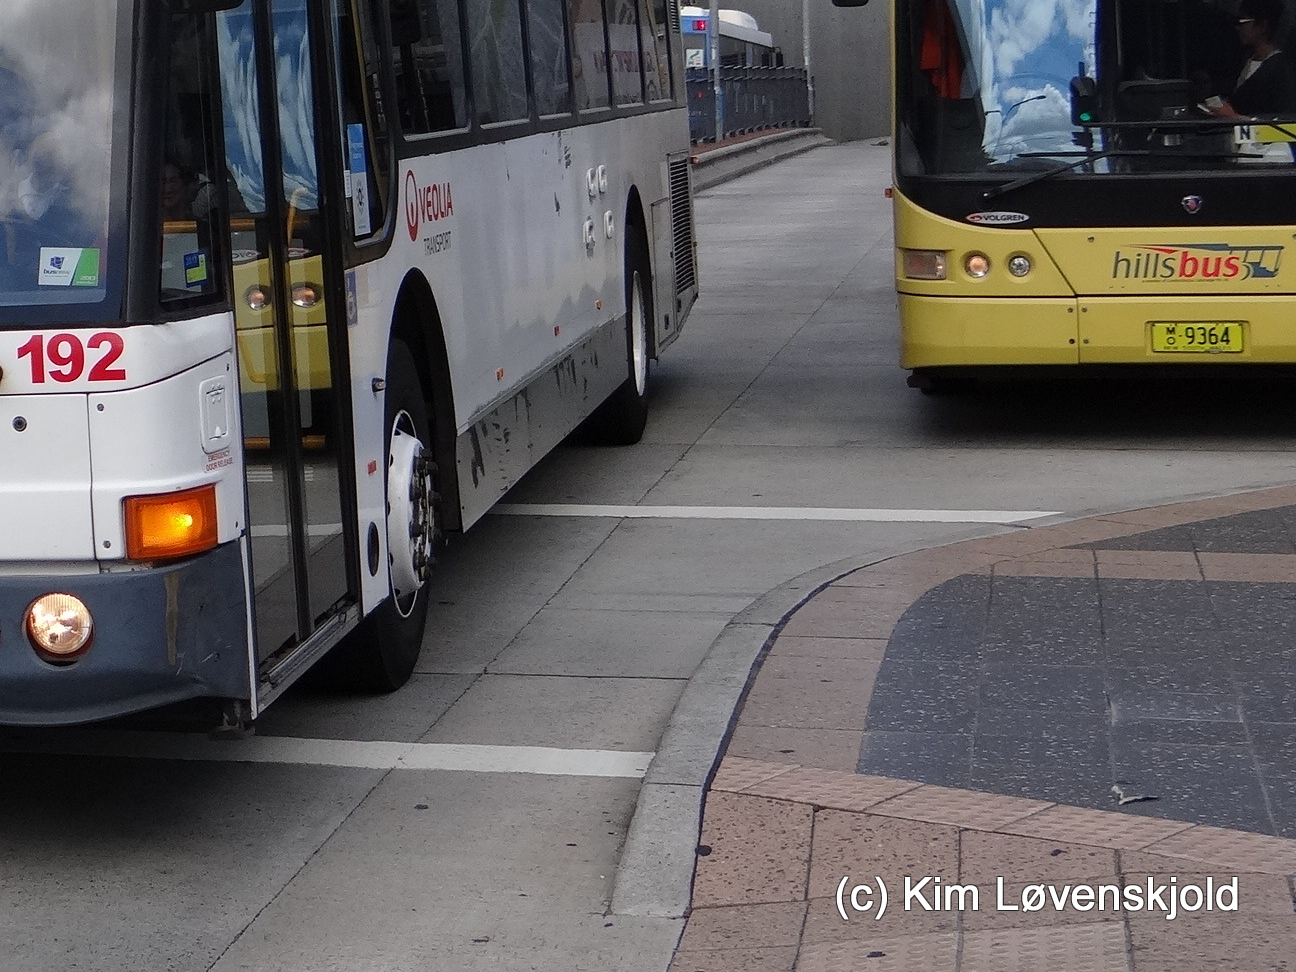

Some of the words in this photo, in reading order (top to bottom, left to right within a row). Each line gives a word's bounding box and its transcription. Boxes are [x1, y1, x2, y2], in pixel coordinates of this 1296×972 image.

[418, 182, 454, 224] VEOLIA
[982, 214, 1025, 223] VOLGREN
[423, 230, 452, 257] TRANSPORT
[1111, 249, 1242, 279] hillsbus
[1184, 326, 1232, 346] 9364
[17, 331, 127, 384] 192
